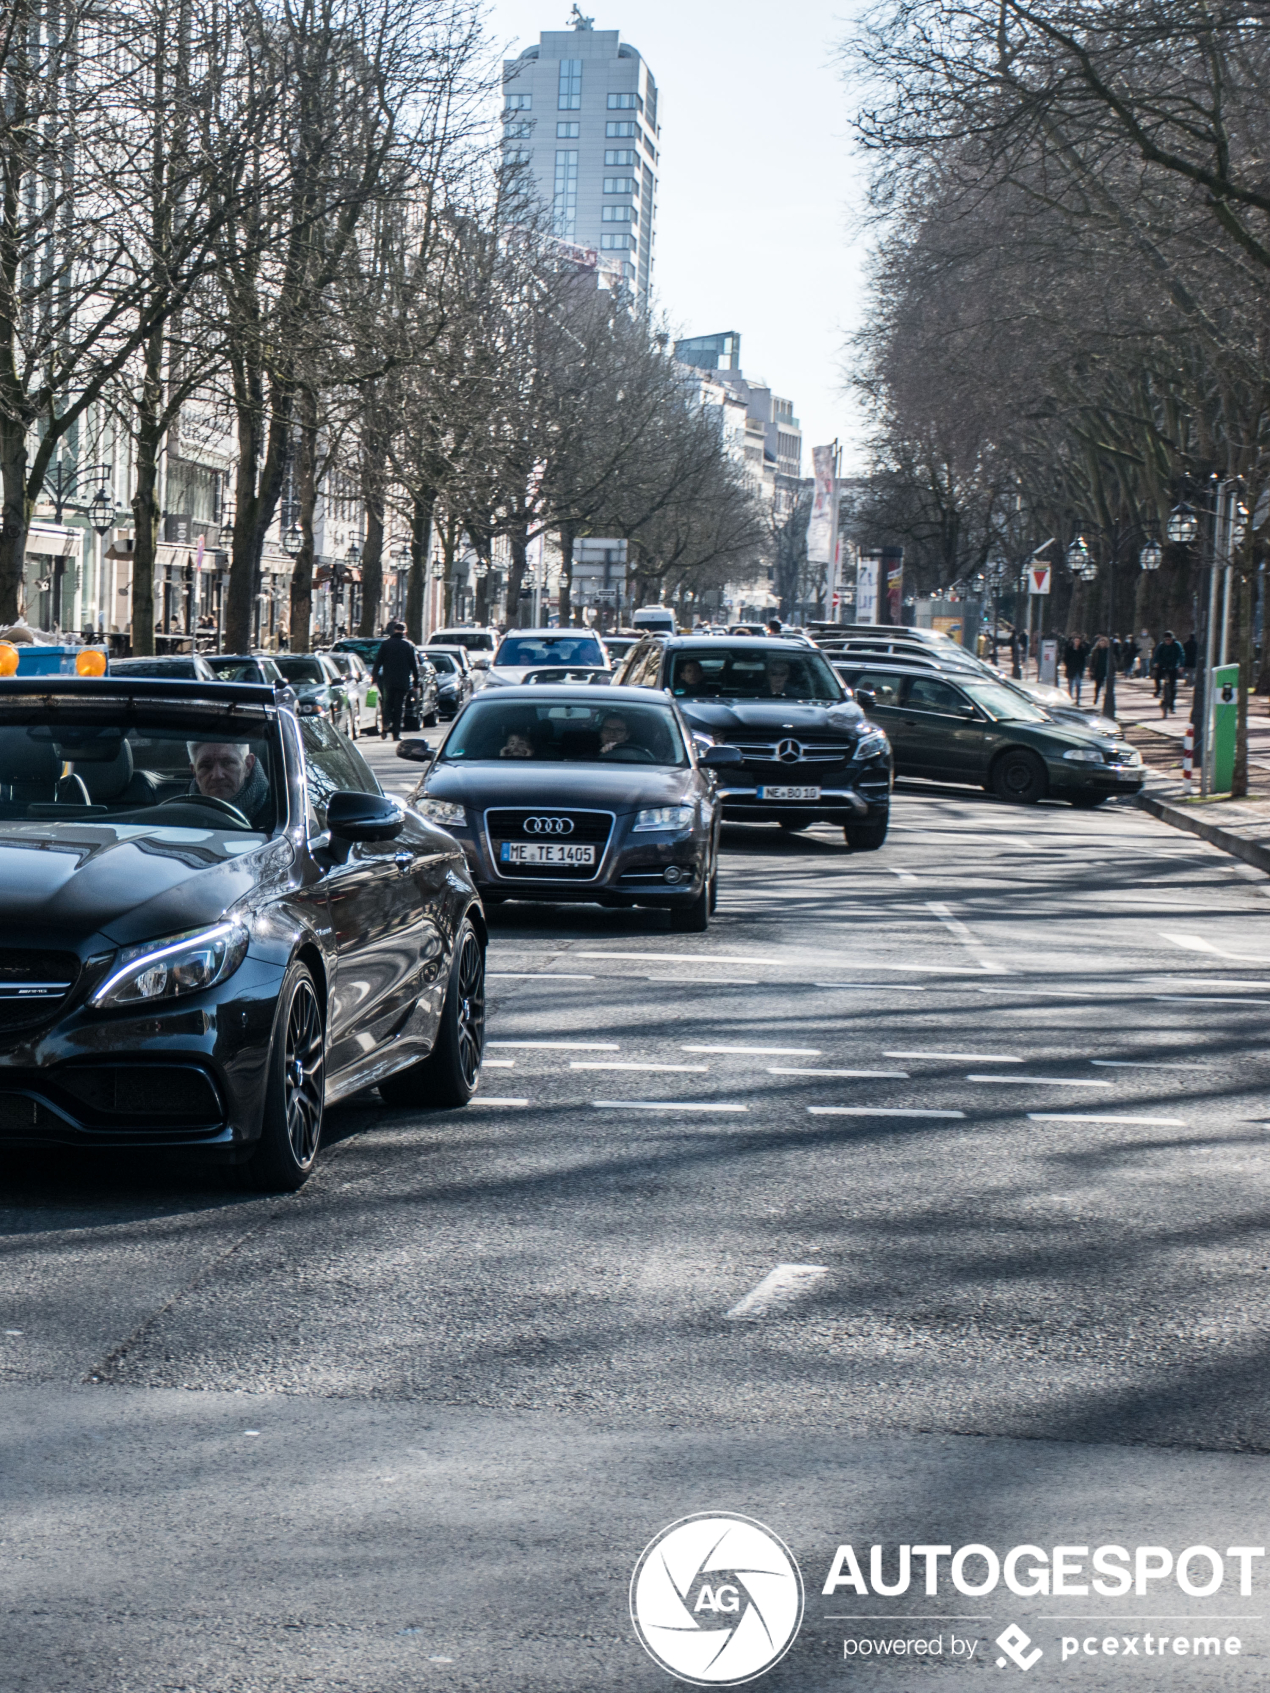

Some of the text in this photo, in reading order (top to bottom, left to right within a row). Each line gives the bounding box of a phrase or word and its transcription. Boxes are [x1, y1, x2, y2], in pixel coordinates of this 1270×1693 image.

[510, 845, 592, 862] ME TE 1405
